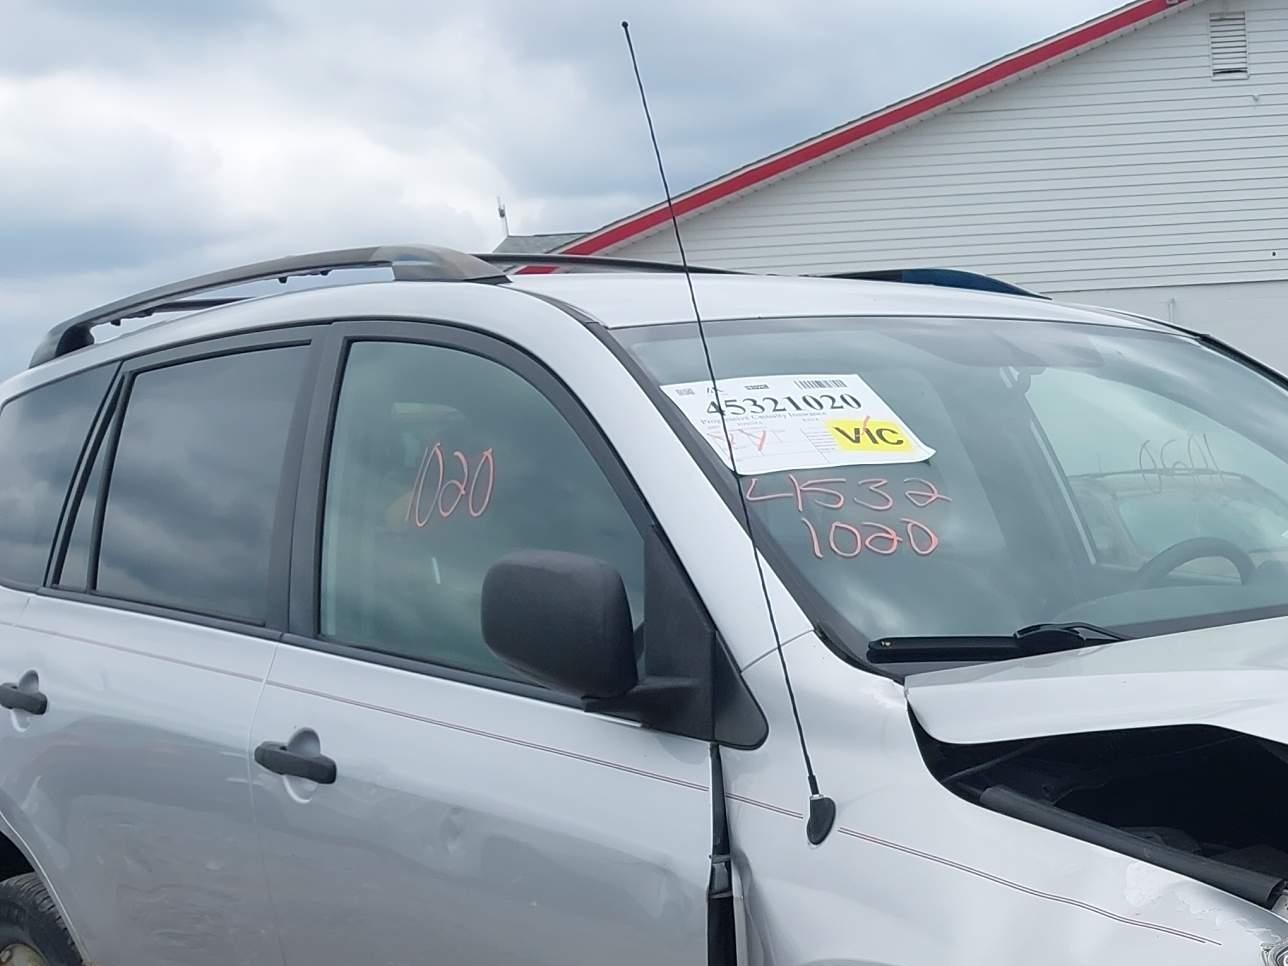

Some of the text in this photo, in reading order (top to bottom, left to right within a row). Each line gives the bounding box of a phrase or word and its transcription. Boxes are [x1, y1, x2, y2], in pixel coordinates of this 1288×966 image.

[706, 393, 862, 417] 45321020
[833, 426, 904, 446] VIC
[404, 442, 494, 528] 1020
[746, 473, 953, 512] 4532
[801, 516, 939, 558] 1020
